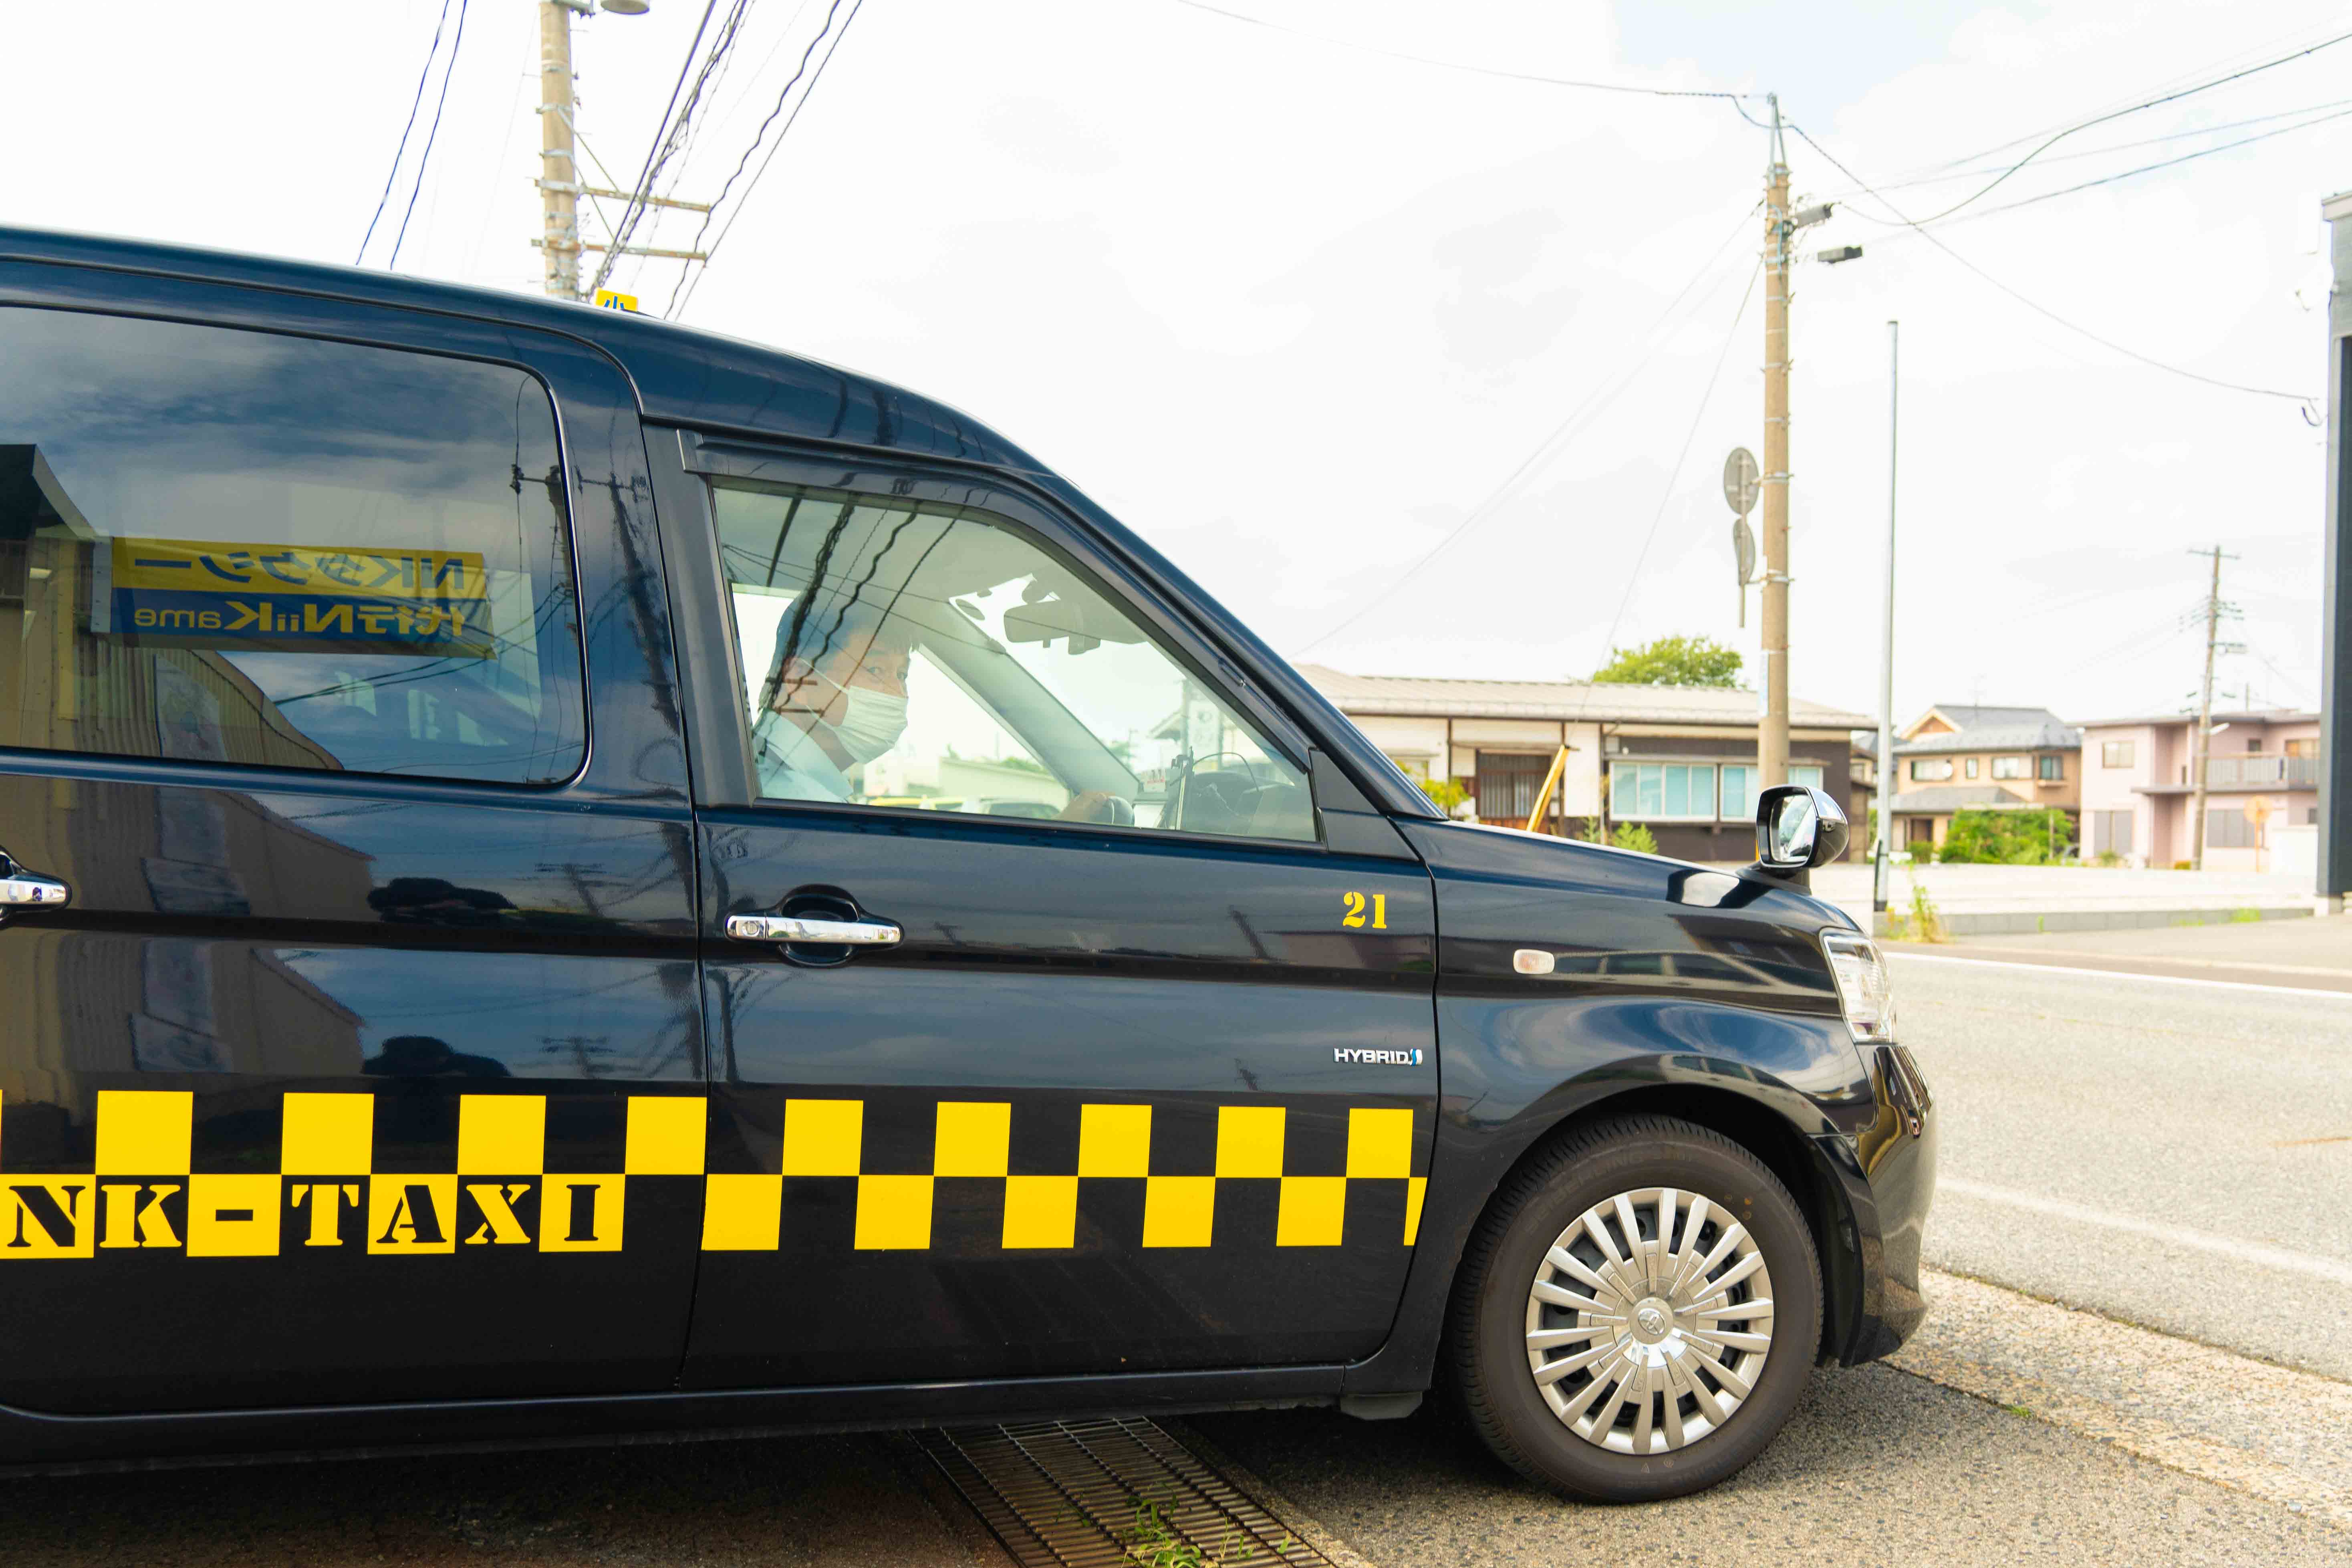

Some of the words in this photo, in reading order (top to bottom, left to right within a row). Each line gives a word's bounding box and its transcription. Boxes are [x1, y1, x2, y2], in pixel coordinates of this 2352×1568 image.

[1343, 891, 1387, 929] 21
[1334, 1048, 1411, 1064] HYBRID
[7, 1184, 601, 1248] NK-TAXI
